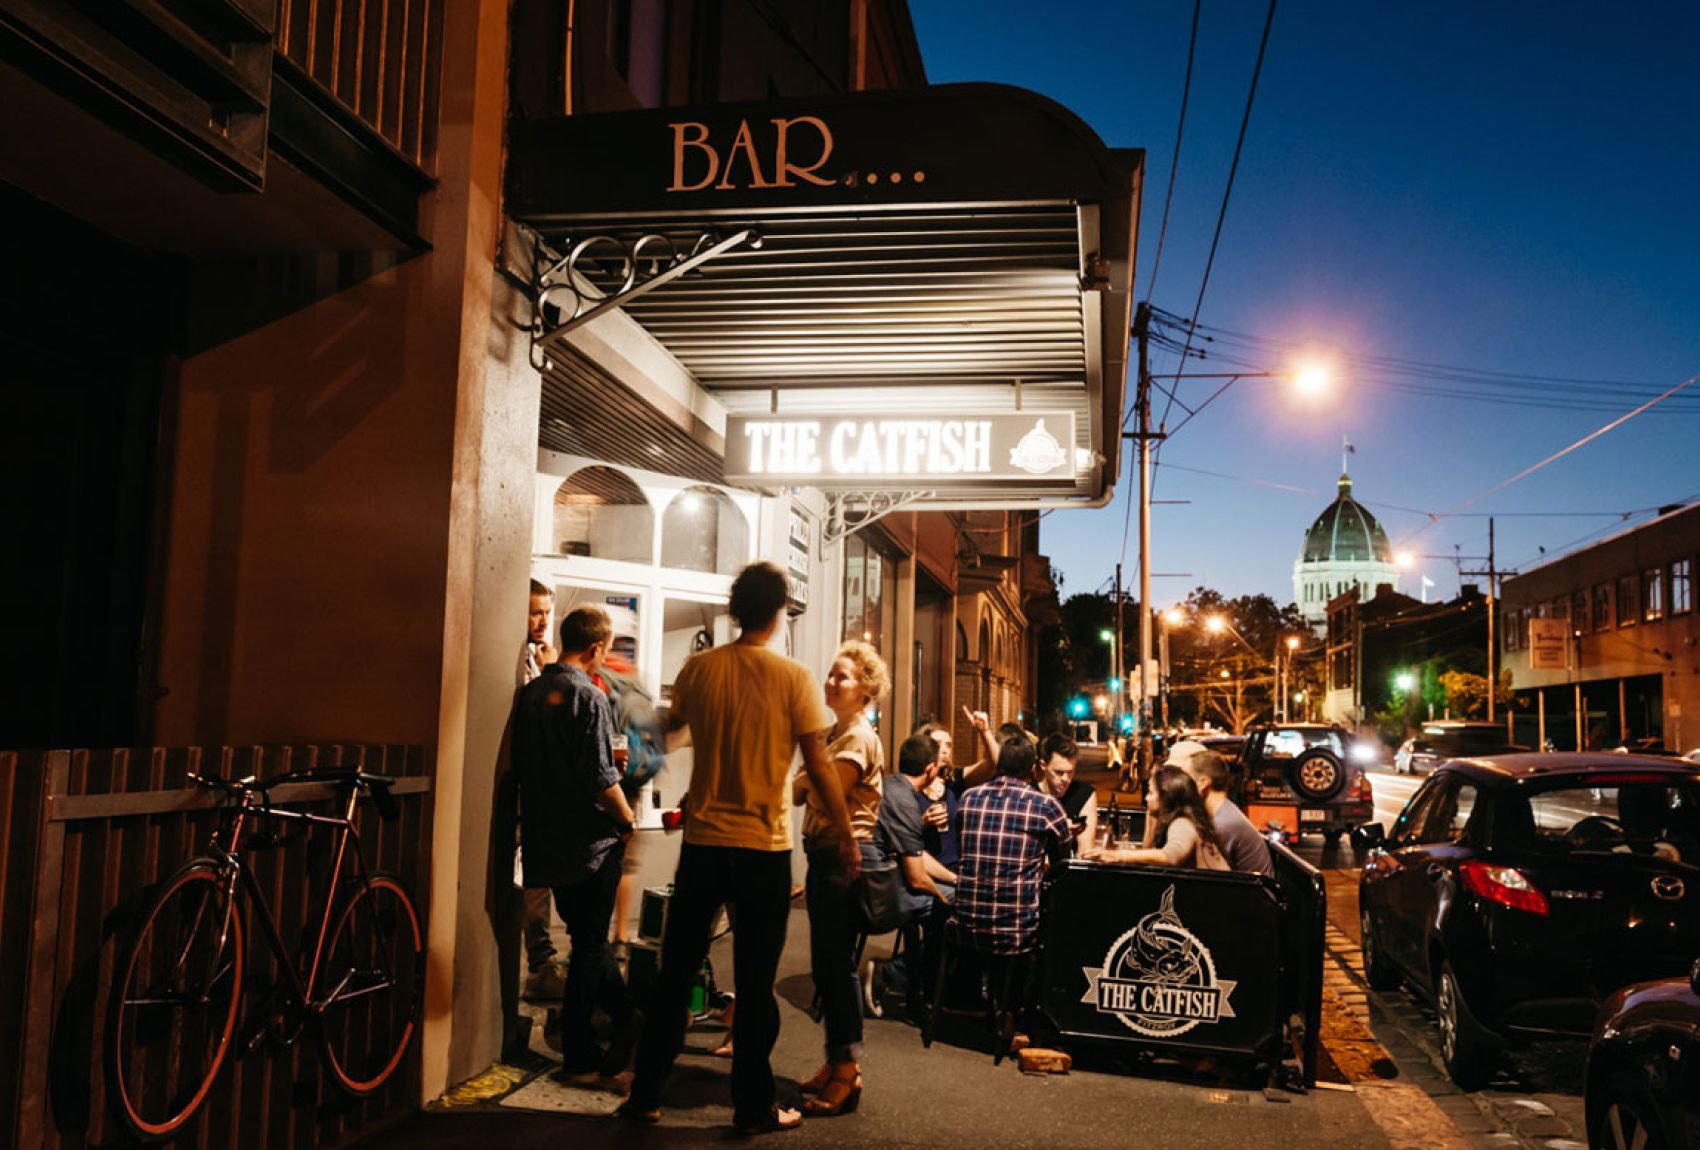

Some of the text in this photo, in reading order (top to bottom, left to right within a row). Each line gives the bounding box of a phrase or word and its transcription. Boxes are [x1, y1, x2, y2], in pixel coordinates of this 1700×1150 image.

[744, 420, 992, 474] THE CATFISH
[1101, 982, 1217, 1018] THE CATFISH
